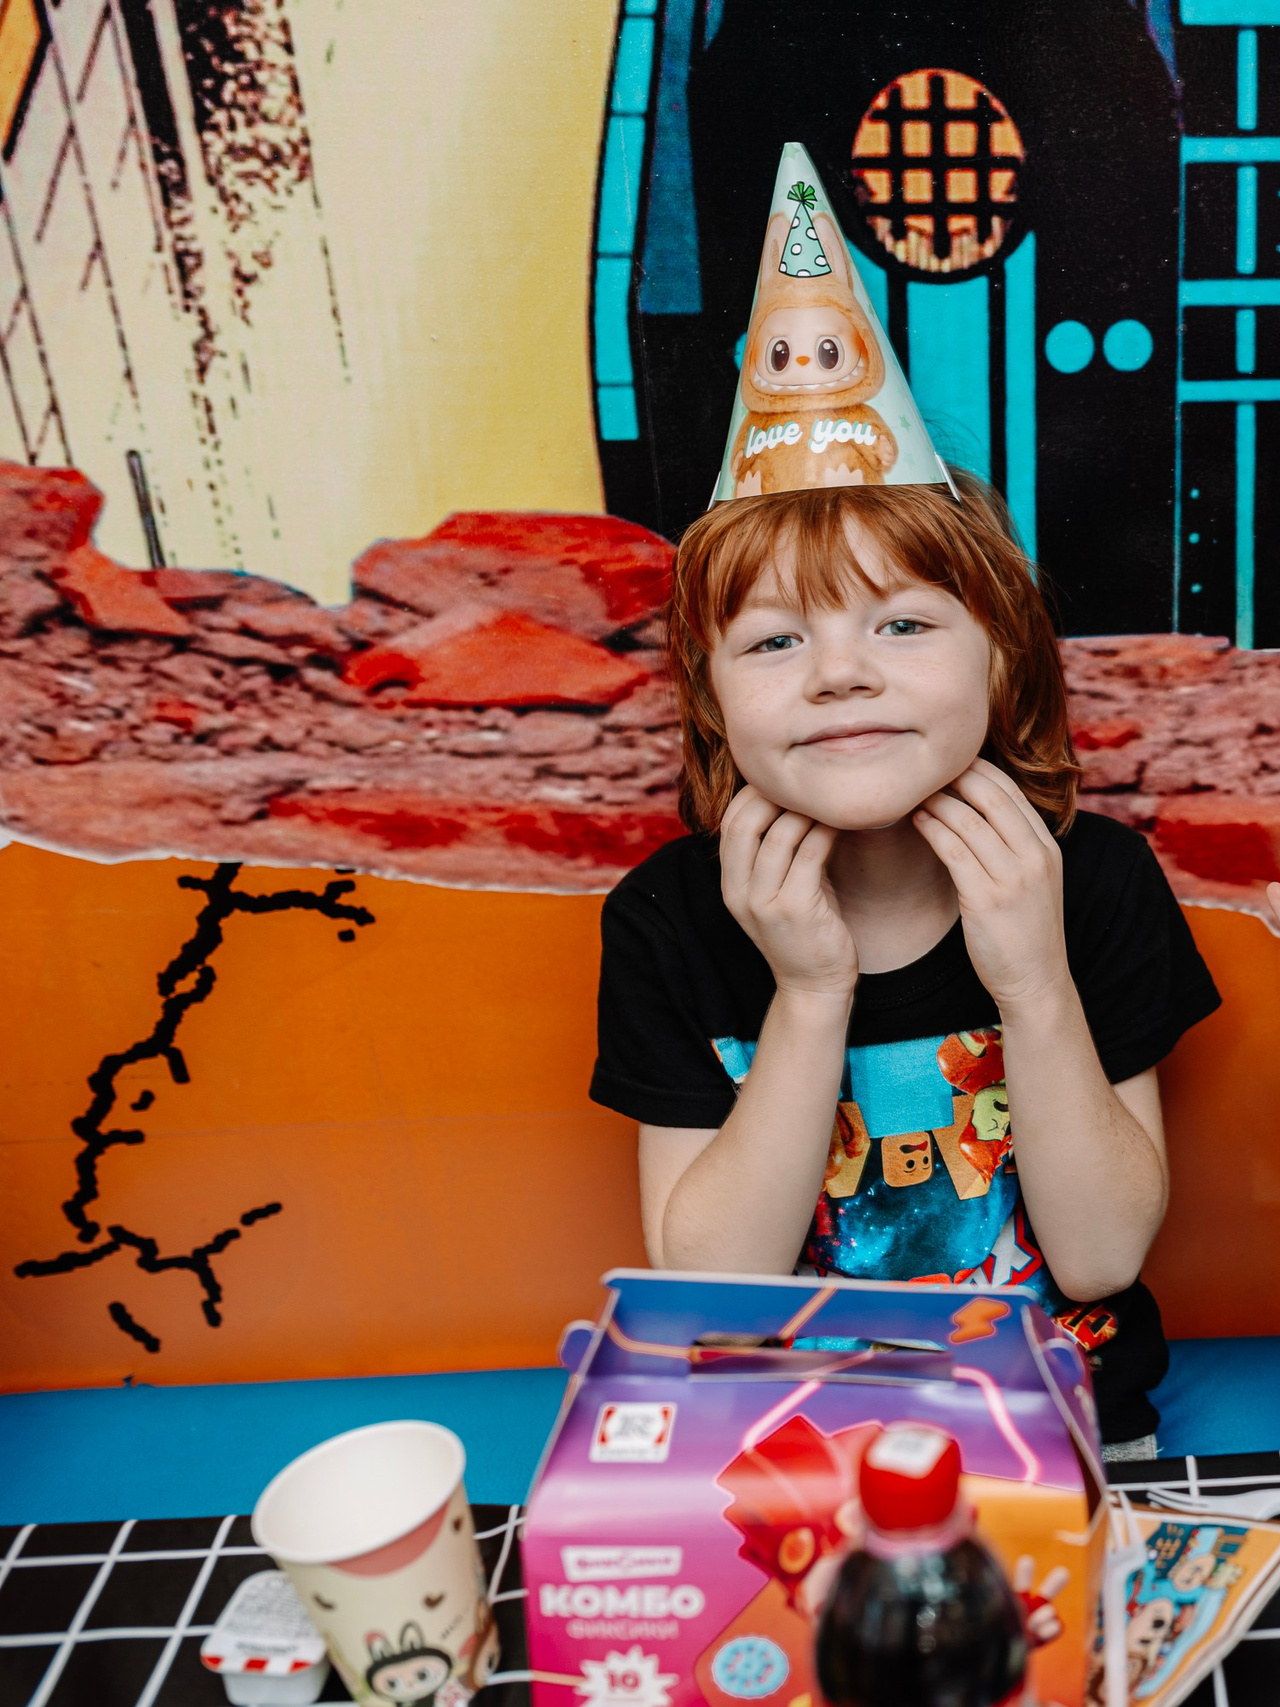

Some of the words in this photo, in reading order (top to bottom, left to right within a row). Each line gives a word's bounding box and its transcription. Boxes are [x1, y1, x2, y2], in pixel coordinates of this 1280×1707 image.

[743, 420, 803, 459] love
[808, 418, 877, 454] you
[539, 1583, 705, 1619] КОМБО
[607, 1671, 640, 1693] 10
